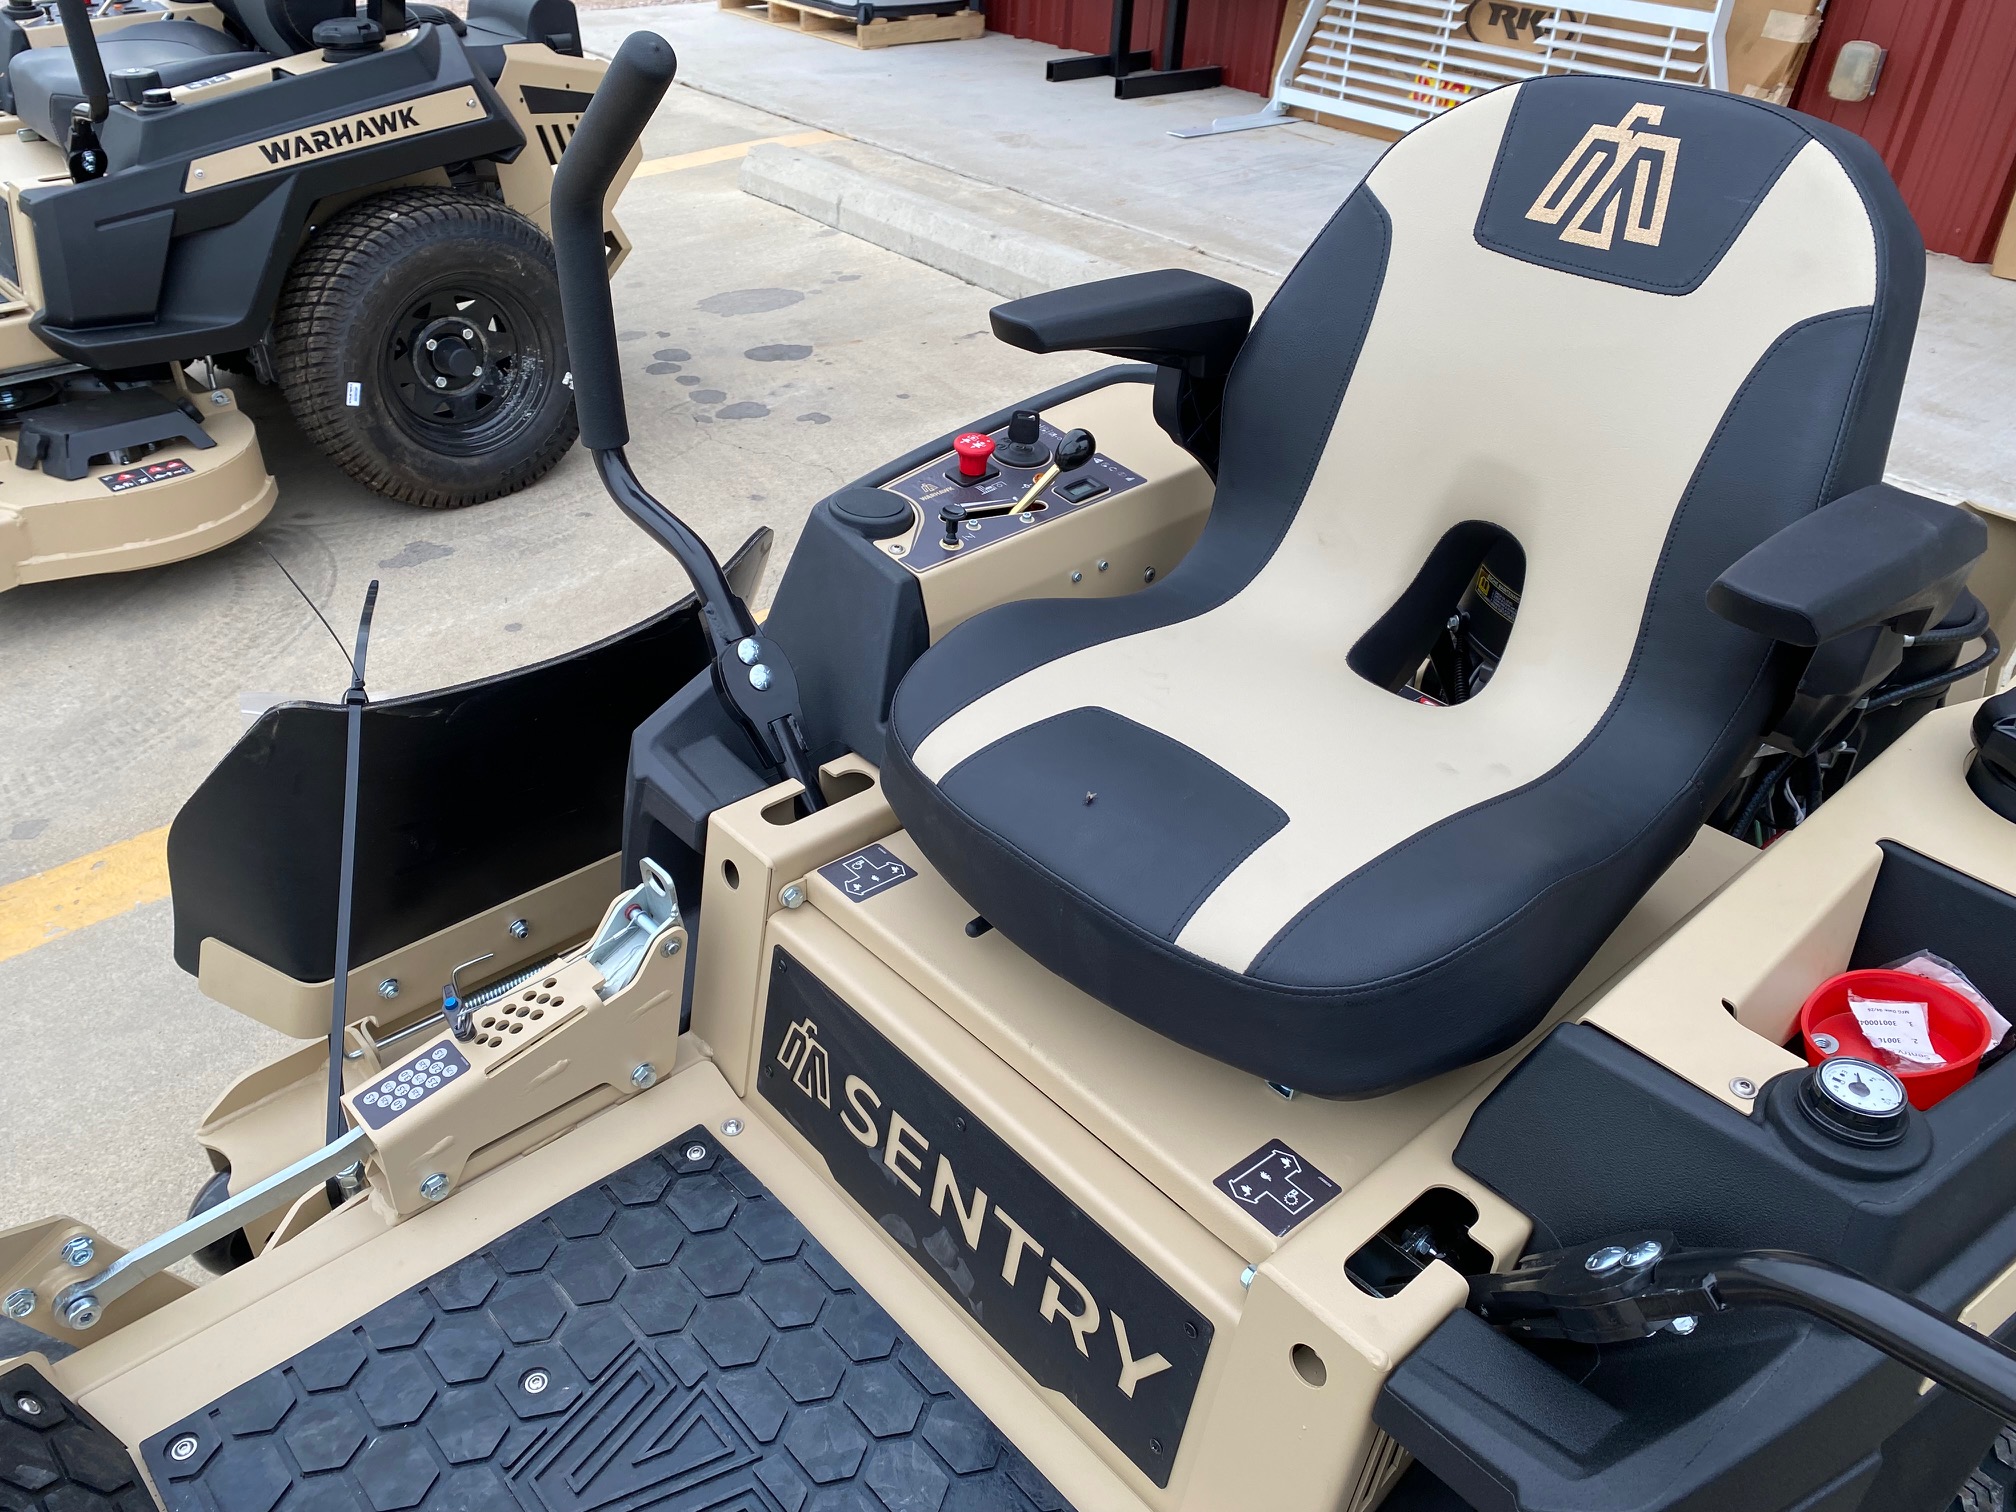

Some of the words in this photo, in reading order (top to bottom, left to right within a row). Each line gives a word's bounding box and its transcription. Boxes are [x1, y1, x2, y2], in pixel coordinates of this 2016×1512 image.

[258, 106, 420, 164] WARHAWK
[1898, 1049, 1931, 1060] Sentry
[838, 1073, 1172, 1399] SENTRY
